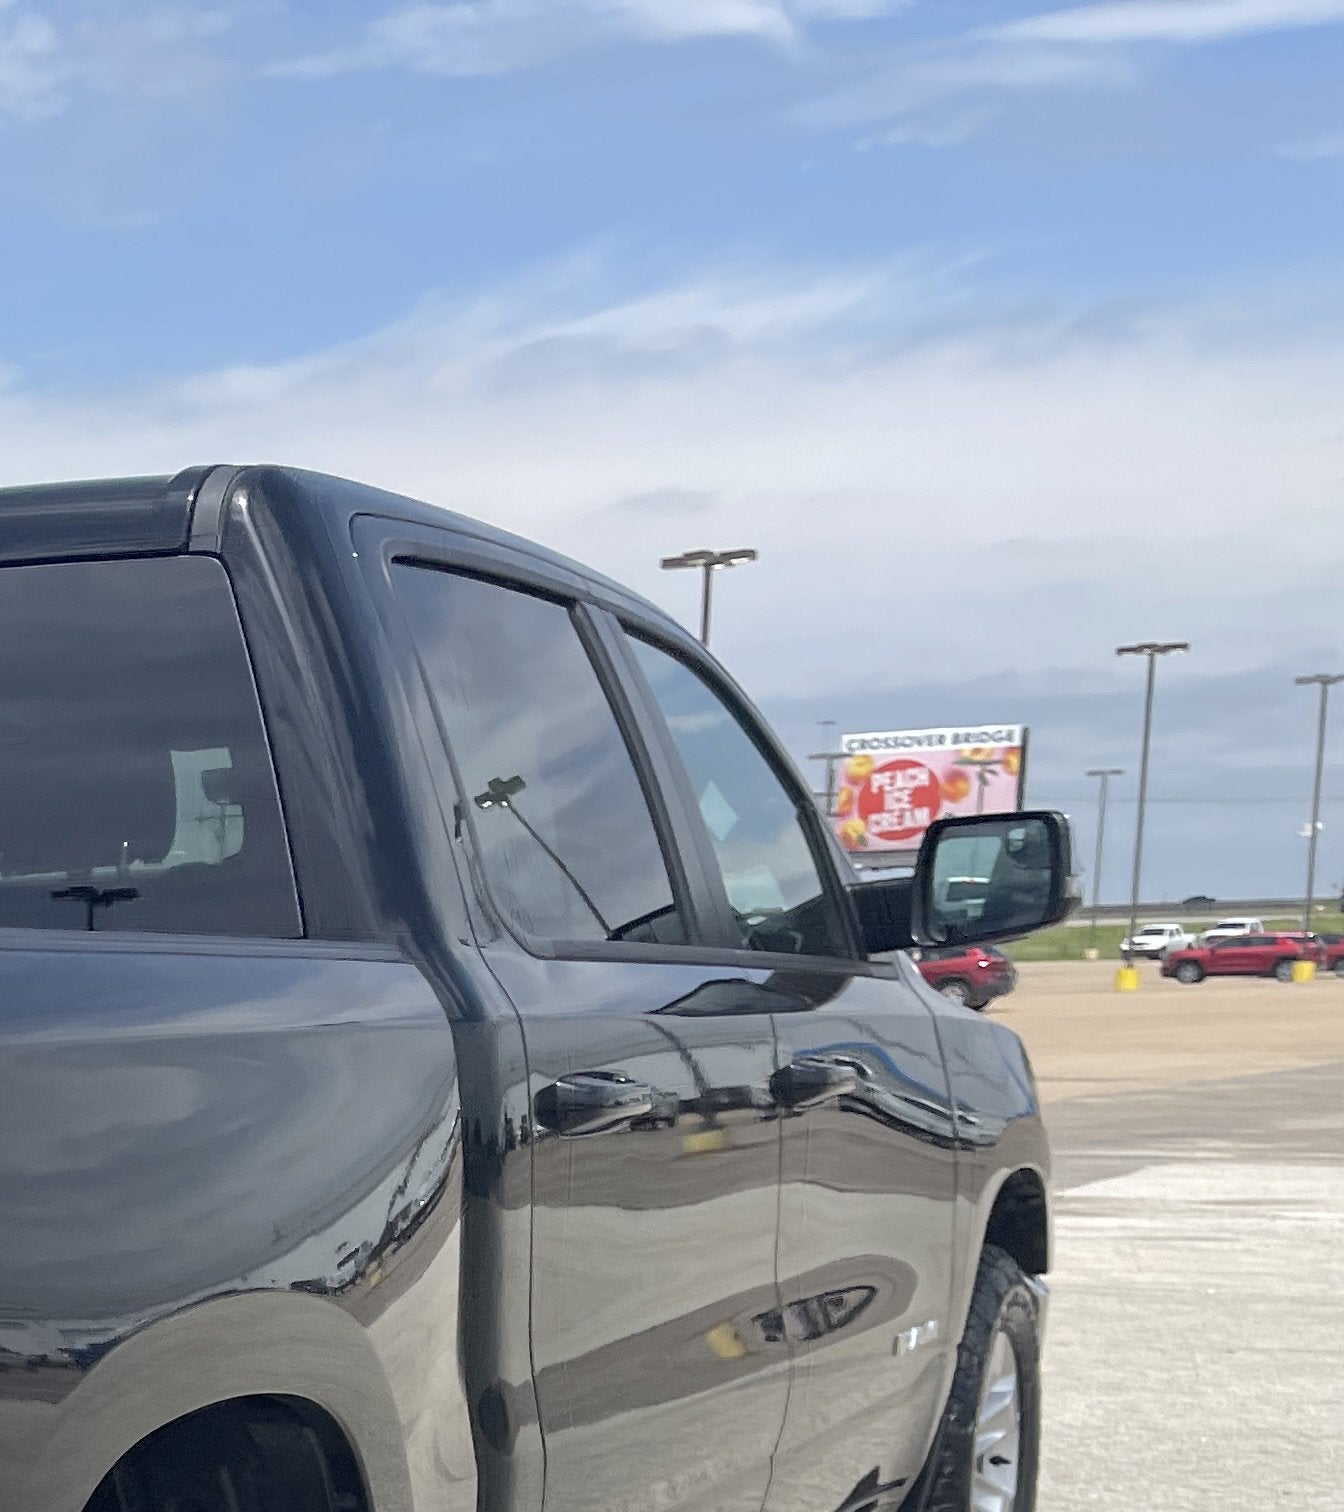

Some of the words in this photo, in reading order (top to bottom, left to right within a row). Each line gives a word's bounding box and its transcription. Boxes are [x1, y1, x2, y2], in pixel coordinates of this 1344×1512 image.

[846, 733, 947, 750] CROSSOVER
[951, 728, 1015, 745] BRIDGE
[870, 767, 929, 793] PEACH
[883, 789, 913, 811] ICE
[868, 807, 931, 833] CREAM
